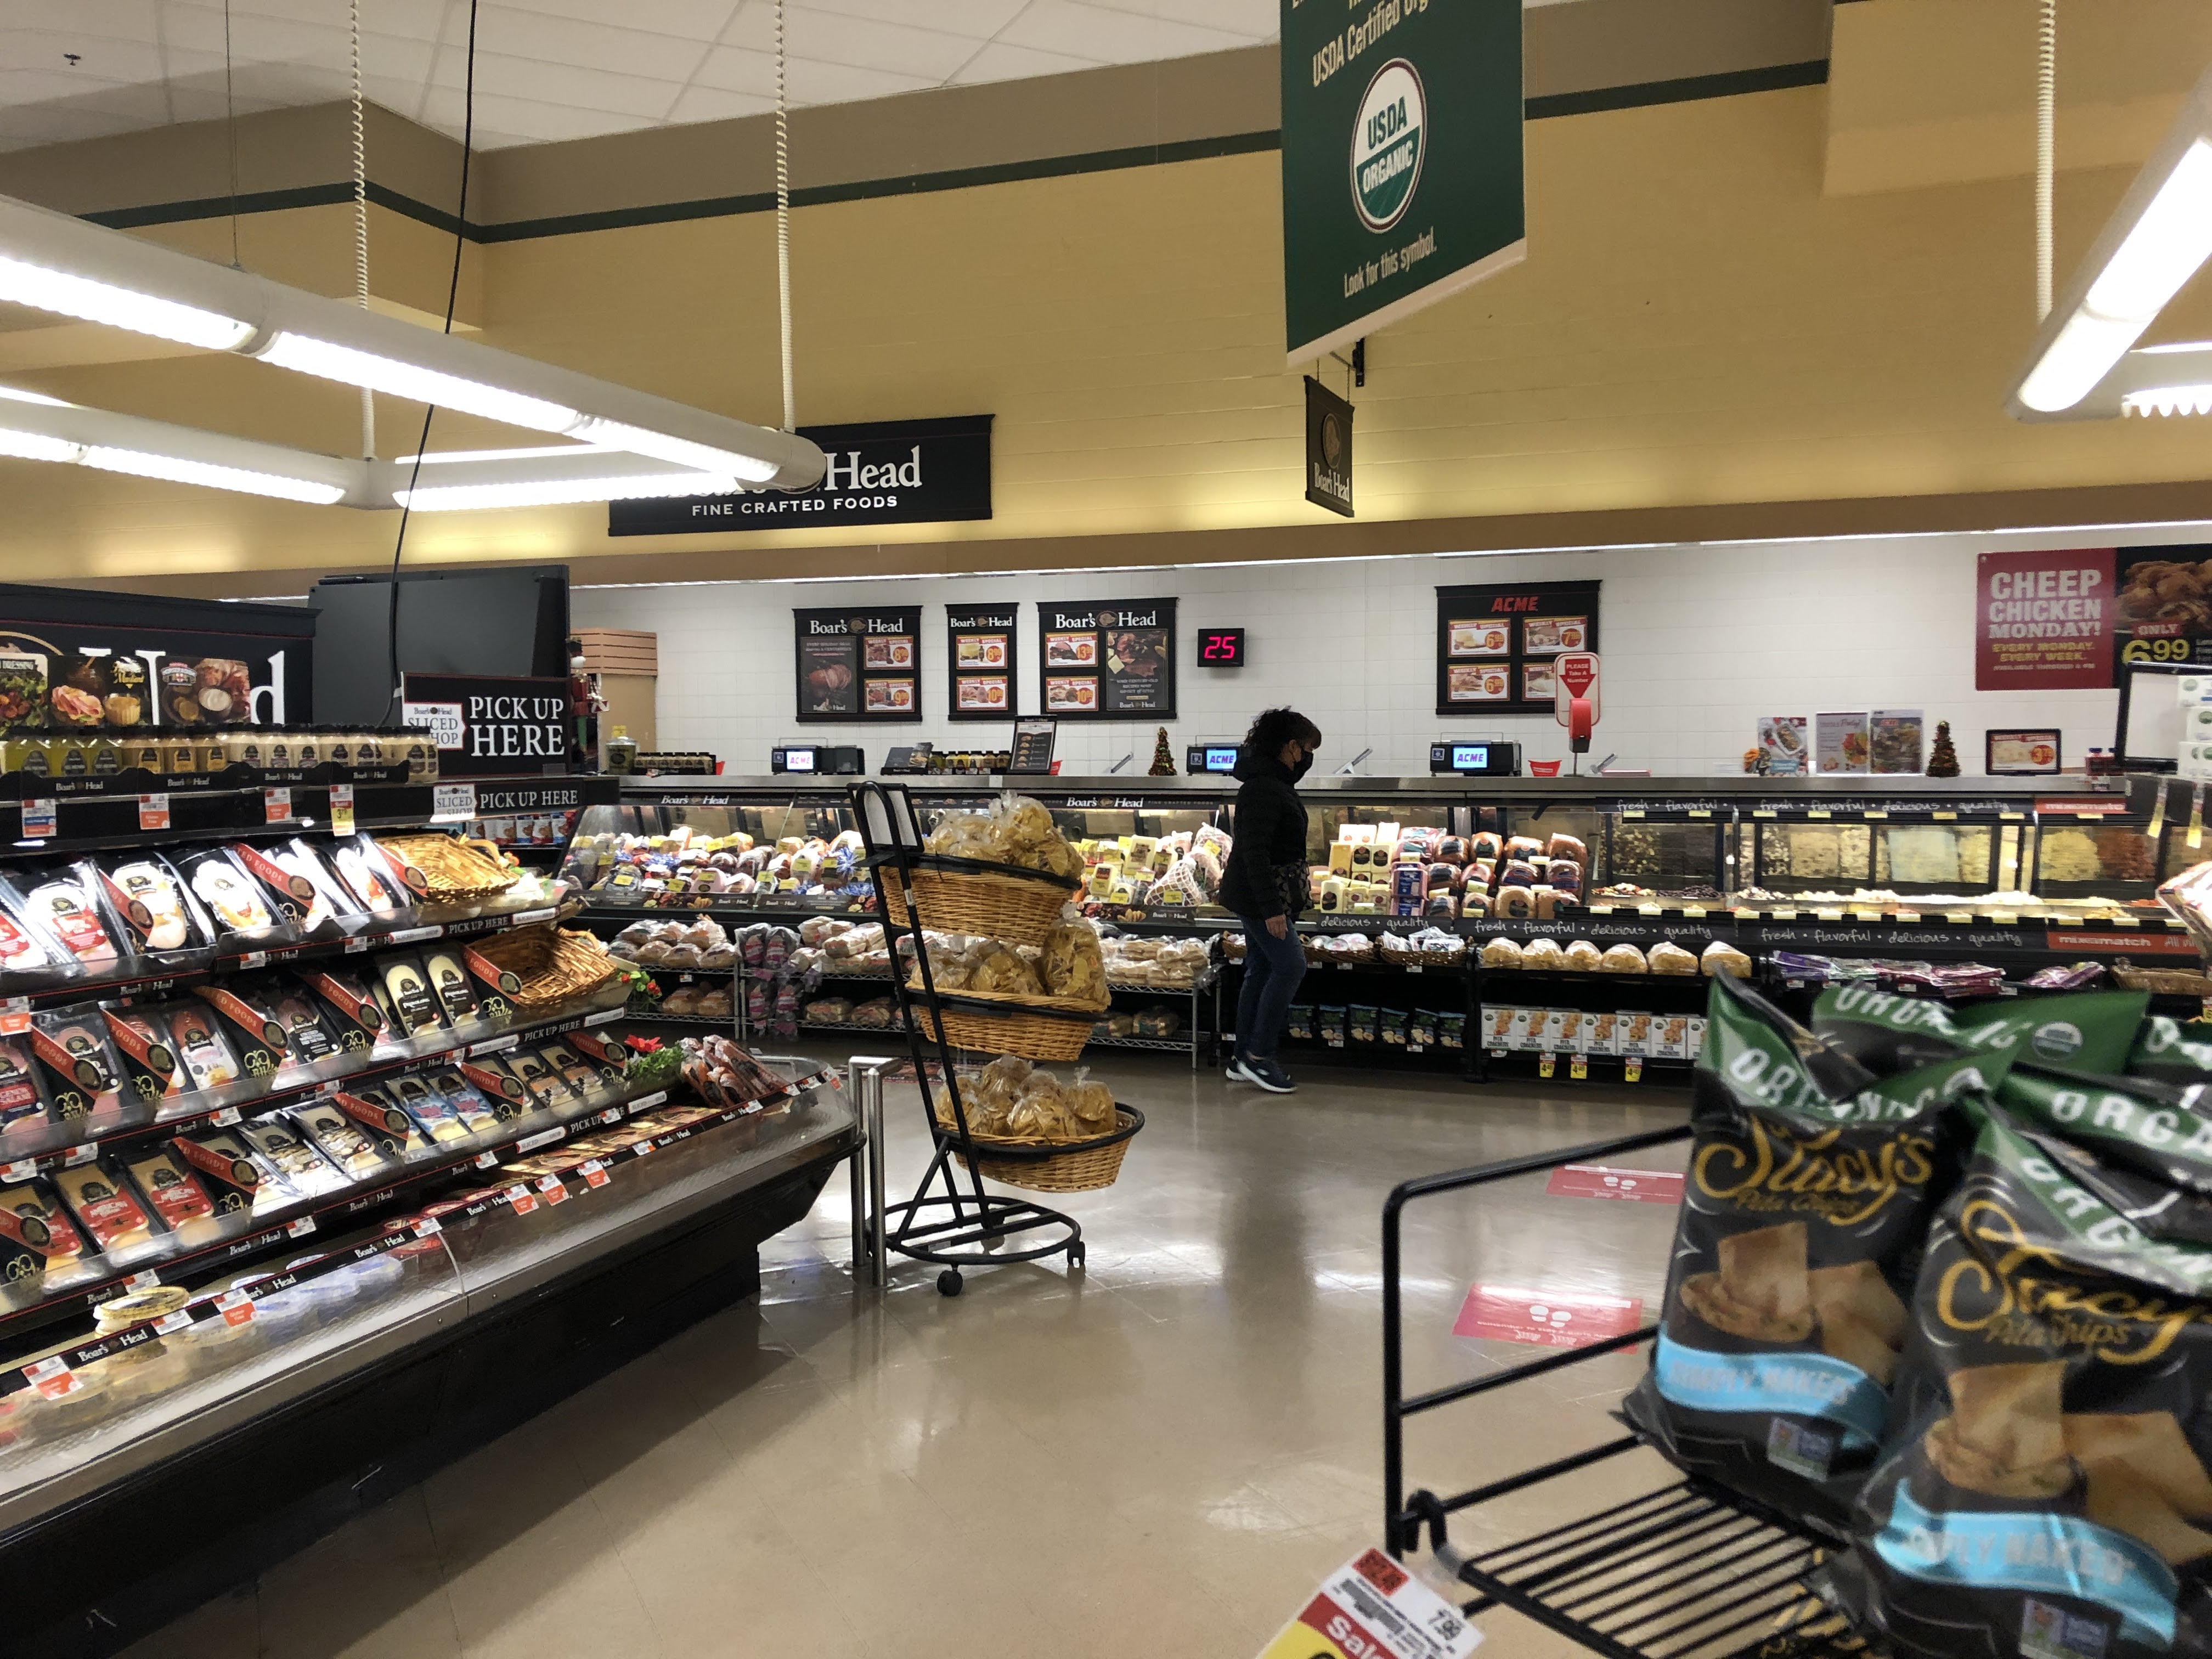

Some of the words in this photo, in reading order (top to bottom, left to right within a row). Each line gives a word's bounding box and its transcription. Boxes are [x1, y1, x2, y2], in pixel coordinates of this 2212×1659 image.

[1313, 34, 1345, 87] USDA
[1347, 0, 1401, 61] Certified
[1367, 96, 1408, 150] USDA
[1362, 140, 1413, 195] ORGANIC
[1344, 268, 1365, 298] Look
[1365, 260, 1380, 286] for
[1380, 249, 1398, 275] this
[1400, 226, 1437, 273] symbol.
[824, 445, 922, 492] Head
[1314, 462, 1333, 495] Boar's
[1333, 471, 1350, 503] Head
[692, 504, 734, 517] FINE
[741, 498, 825, 515] CRAFTED
[833, 495, 898, 510] FOODS
[1990, 569, 2102, 600] CHEEP
[1490, 596, 1539, 612] ACME
[1989, 599, 2102, 623] CHICKEN
[810, 619, 848, 634] Boar's
[867, 617, 904, 633] Head
[950, 617, 976, 628] Boar's
[989, 616, 1013, 627] Head
[1055, 612, 1096, 629] Boar's
[1118, 610, 1156, 627] Head
[1988, 622, 2102, 639] MONDAY!
[1204, 635, 1237, 659] 25
[469, 696, 528, 720] PICK
[532, 698, 564, 720] UP
[408, 717, 458, 730] SLICED
[431, 732, 458, 745] HOP
[470, 724, 566, 757] HERE
[1209, 755, 1234, 764] ACME
[1457, 753, 1485, 762] ACME
[436, 795, 473, 809] SLICED
[479, 792, 515, 810] PICK
[518, 791, 537, 808] UP
[540, 789, 578, 806] HERE
[661, 795, 689, 805] Boar's
[702, 794, 730, 805] Head
[1066, 797, 1098, 808] Boar's
[1114, 797, 1143, 808] Head
[1617, 799, 1649, 811] fresh
[1665, 799, 1718, 811] flavorful
[1759, 799, 1793, 811] fresh
[1811, 799, 1865, 812] flavorful
[254, 860, 283, 882] FOODS
[449, 923, 471, 934] PICK
[472, 921, 483, 932] UP
[484, 917, 509, 930] HERE
[1320, 914, 1372, 927] delicious
[1386, 918, 1429, 932] quality
[1474, 921, 1507, 933] fresh
[1522, 921, 1576, 934] flavorful
[1590, 923, 1647, 936] delicious
[1663, 926, 1713, 940] quality
[1761, 928, 1797, 943] fresh
[1814, 929, 1871, 943] flavorful
[1888, 932, 1950, 944] delicious
[1968, 932, 2023, 947] quality
[469, 957, 495, 979] FOODS
[327, 984, 354, 1010] FOODS
[229, 1001, 258, 1028] FOODS
[524, 1028, 546, 1042] PICK
[546, 1026, 557, 1036] UP
[557, 1020, 581, 1033] HERE
[475, 1069, 496, 1087] FOODS
[350, 1104, 379, 1120] FOODS
[570, 1119, 590, 1133] PICK
[590, 1115, 602, 1127] UP
[349, 1198, 369, 1212] Boar's
[377, 1189, 394, 1203] Head
[466, 1203, 487, 1216] Boar's
[492, 1192, 509, 1206] Hea
[229, 1240, 252, 1256] Boar's
[261, 1230, 281, 1245] Head
[354, 1244, 379, 1259] Boar's
[384, 1233, 406, 1248] Head
[247, 1286, 264, 1300] ar's
[272, 1273, 297, 1290] Head
[77, 1344, 109, 1363] Boar's
[120, 1329, 149, 1347] Head
